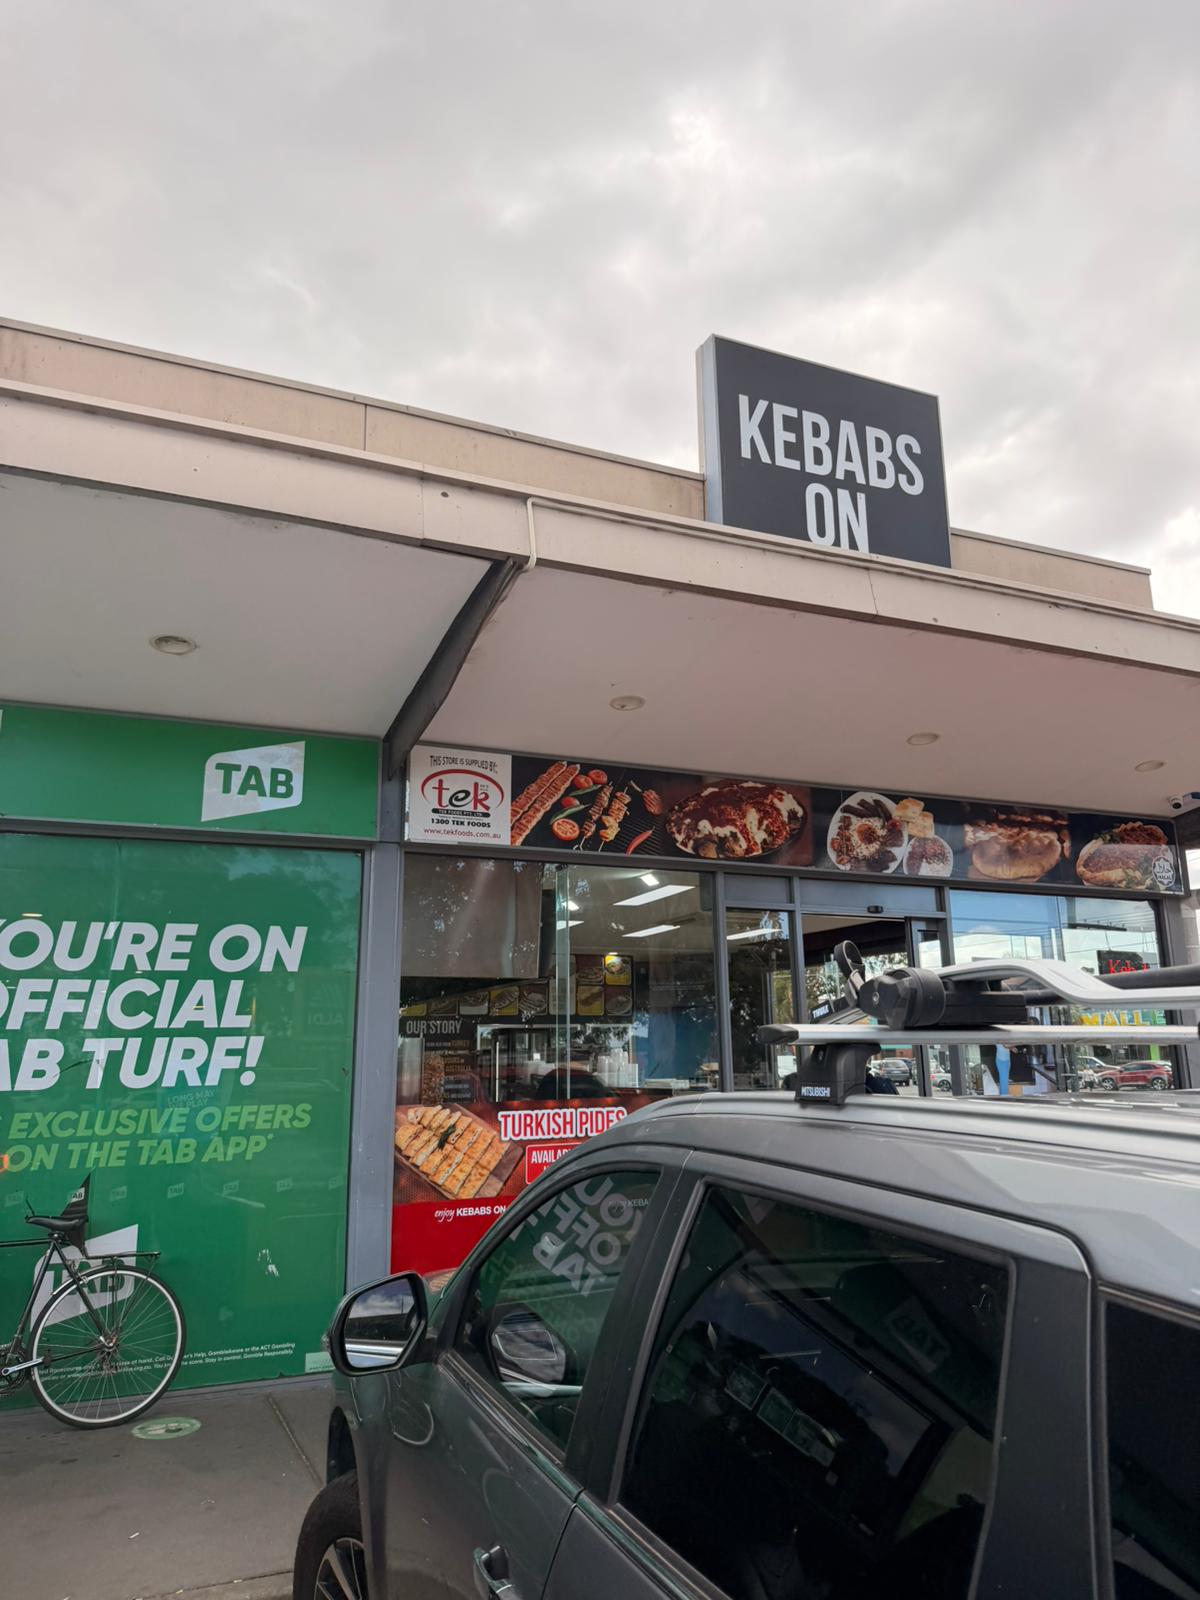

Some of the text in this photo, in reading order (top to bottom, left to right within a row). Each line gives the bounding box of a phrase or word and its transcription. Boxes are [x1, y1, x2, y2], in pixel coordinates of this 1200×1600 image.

[738, 394, 925, 496] KEBABS
[805, 482, 870, 554] ON
[430, 755, 441, 767] THIS
[442, 756, 459, 766] STORE
[459, 757, 465, 765] IS
[465, 758, 488, 770] SUPPLIED
[215, 762, 294, 799] TAB
[432, 778, 490, 812] tek
[424, 828, 501, 838] www.tekfoods.com.au
[467, 820, 491, 828] FOODS
[0, 918, 308, 973] OU'RE ON
[0, 978, 253, 1030] FFICIAL
[406, 1020, 461, 1035] OUR STORY
[82, 1035, 265, 1091] TURF!
[8, 1103, 312, 1140] EXCLUSIVE OFFERS
[499, 1108, 575, 1140] TURKISH
[6, 1143, 59, 1173] ON
[67, 1140, 134, 1169] THE
[138, 1137, 197, 1166] TAB
[531, 1148, 571, 1164] AVAILA
[434, 1204, 506, 1222] enjoy KEBABS ON
[271, 1342, 295, 1350] Gambling
